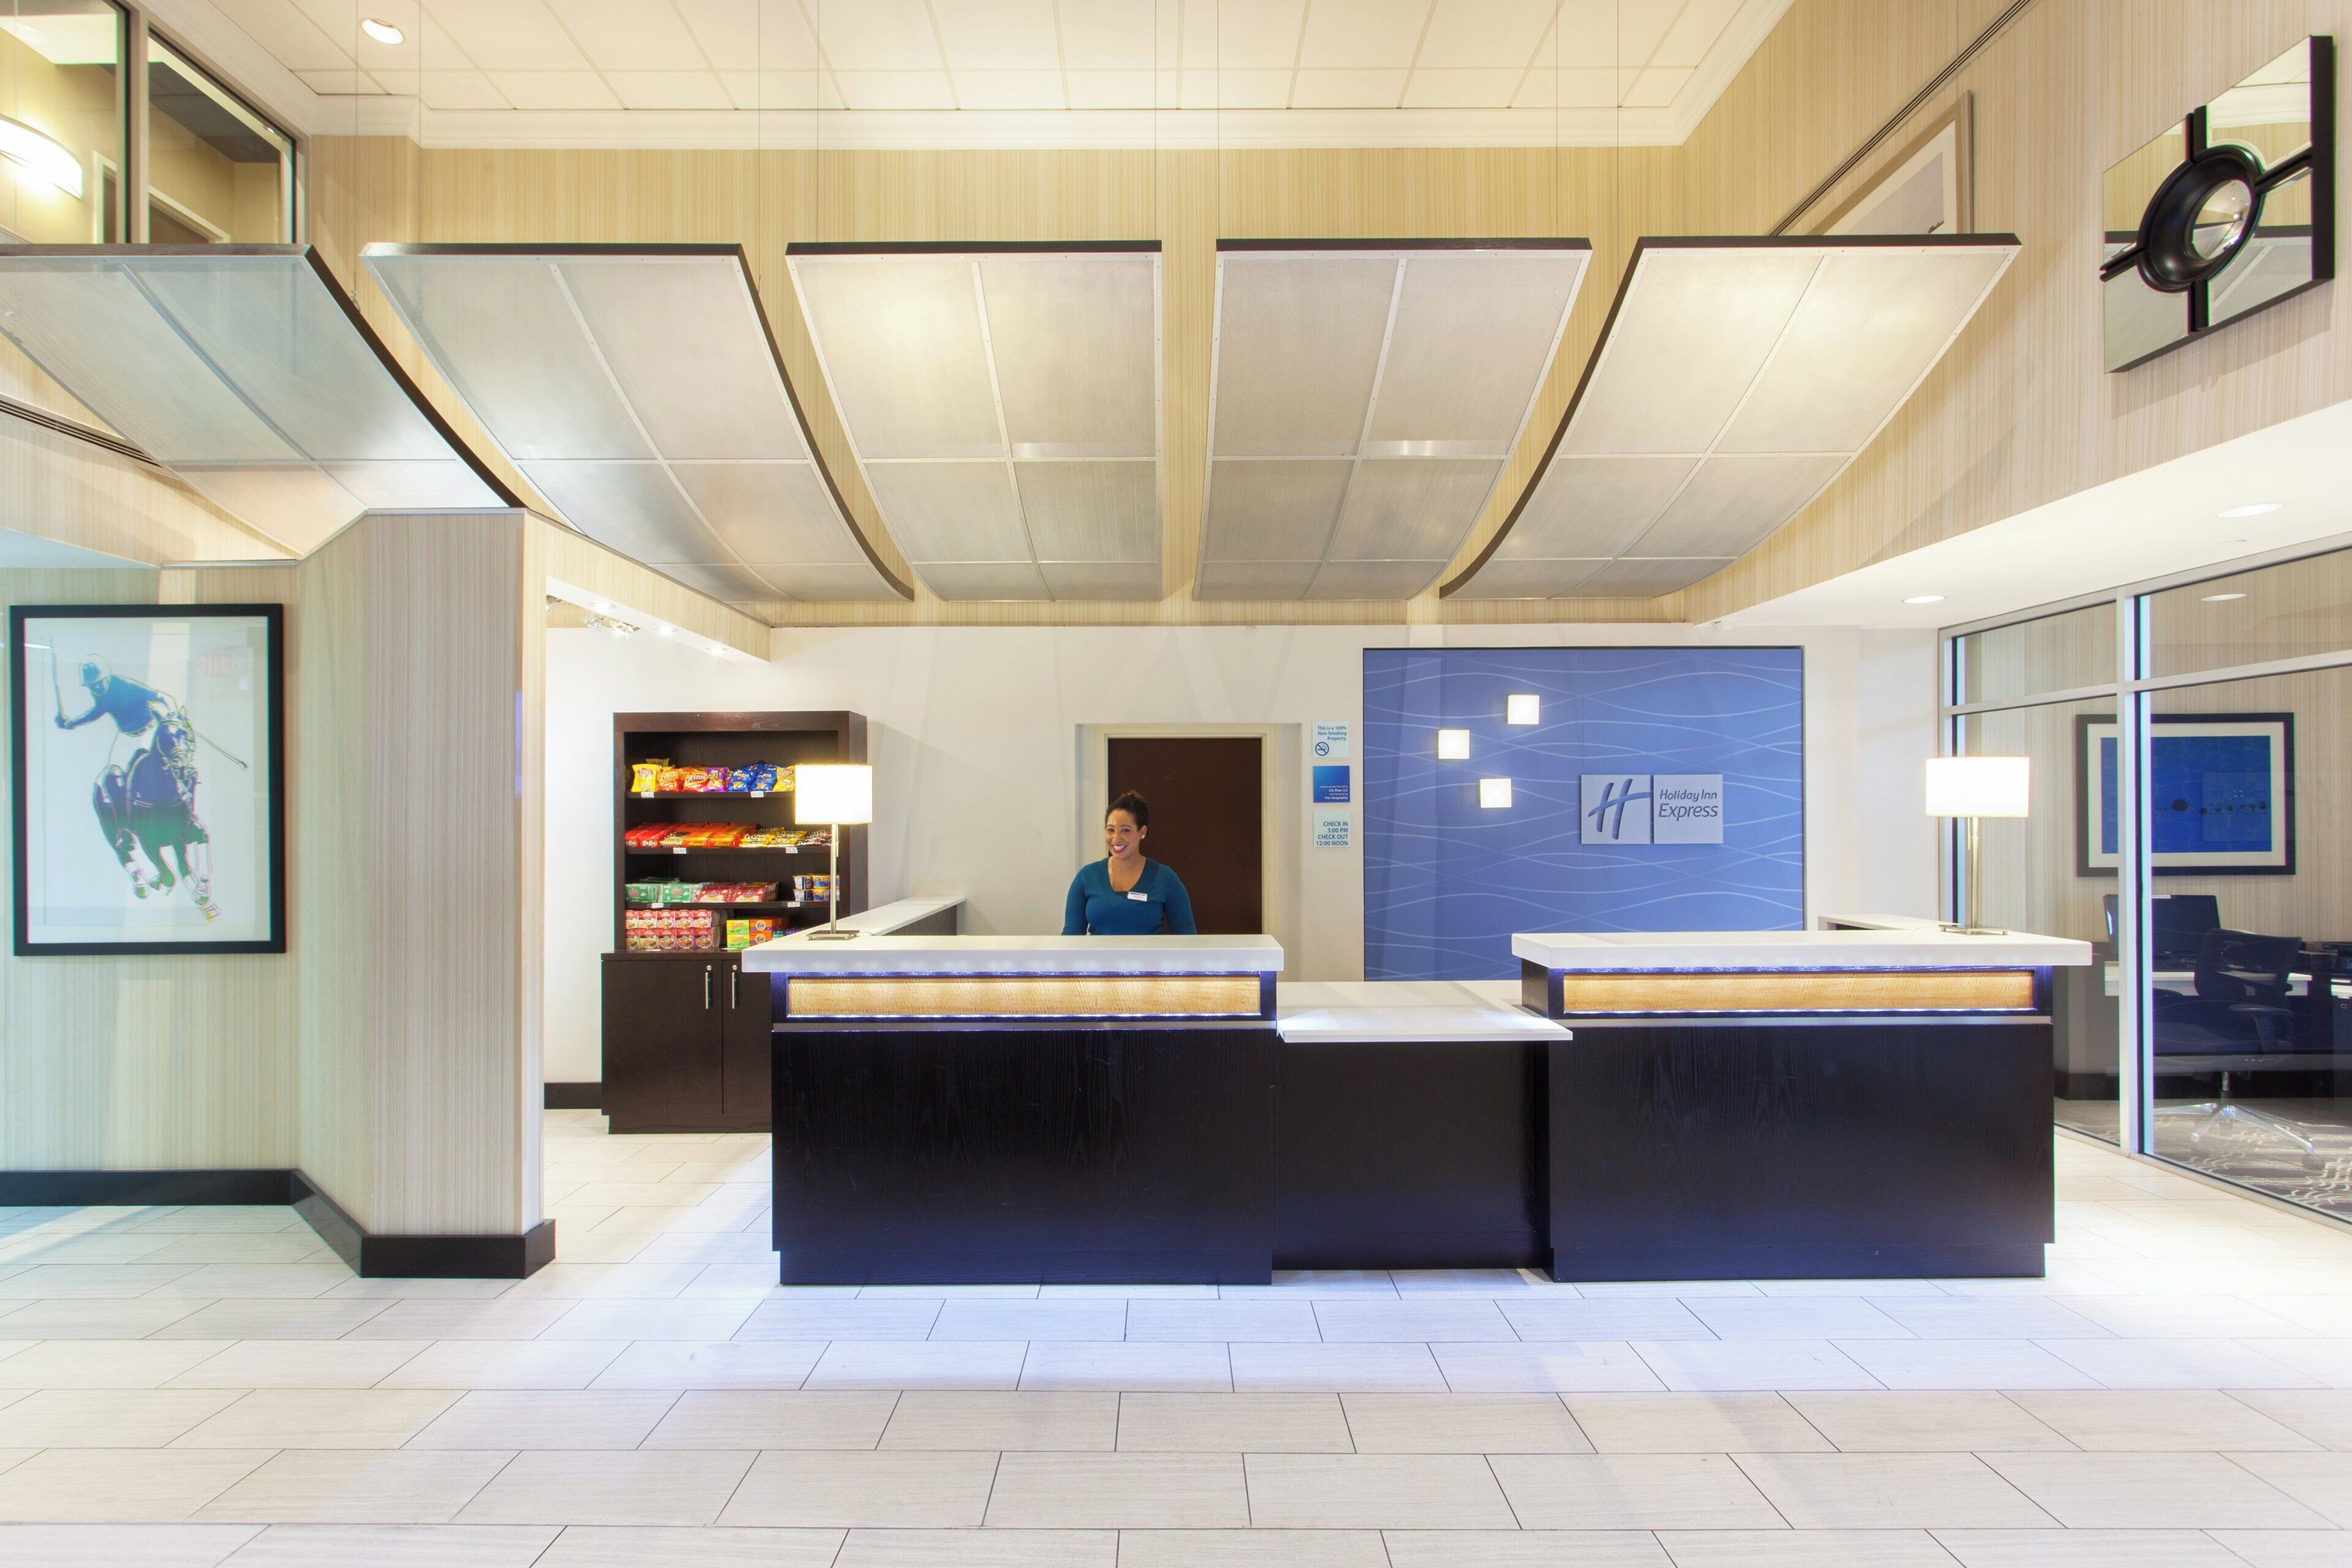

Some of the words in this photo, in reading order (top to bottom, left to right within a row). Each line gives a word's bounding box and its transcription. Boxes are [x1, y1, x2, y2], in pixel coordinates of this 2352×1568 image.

[1659, 790, 1700, 802] Holiday
[1701, 790, 1717, 800] Inn
[1658, 803, 1718, 821] Express
